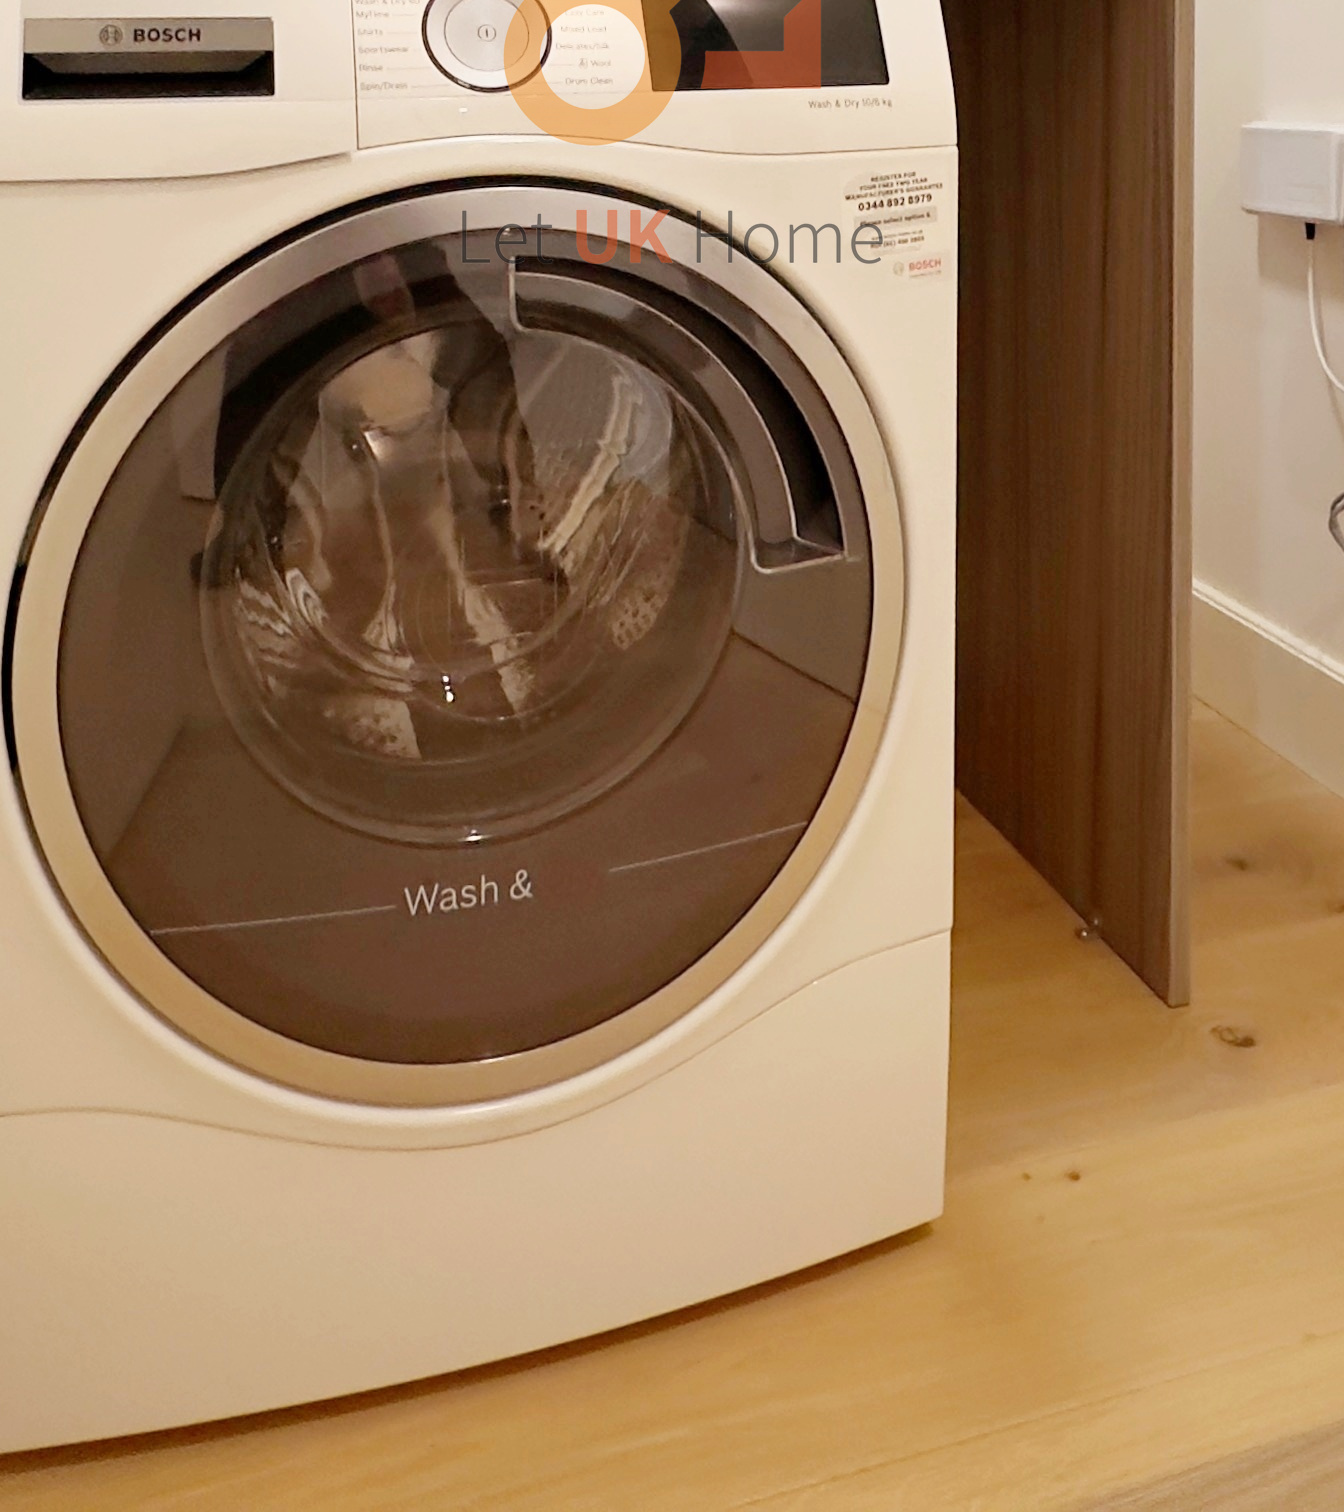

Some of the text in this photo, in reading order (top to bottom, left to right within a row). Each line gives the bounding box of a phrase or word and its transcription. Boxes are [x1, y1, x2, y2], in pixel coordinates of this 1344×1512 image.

[132, 27, 202, 43] BOSCH
[808, 99, 832, 109] Wash
[844, 98, 860, 110] Dry
[886, 196, 905, 208] 892
[908, 258, 942, 271] BOSCH
[403, 869, 534, 917] Wash &
